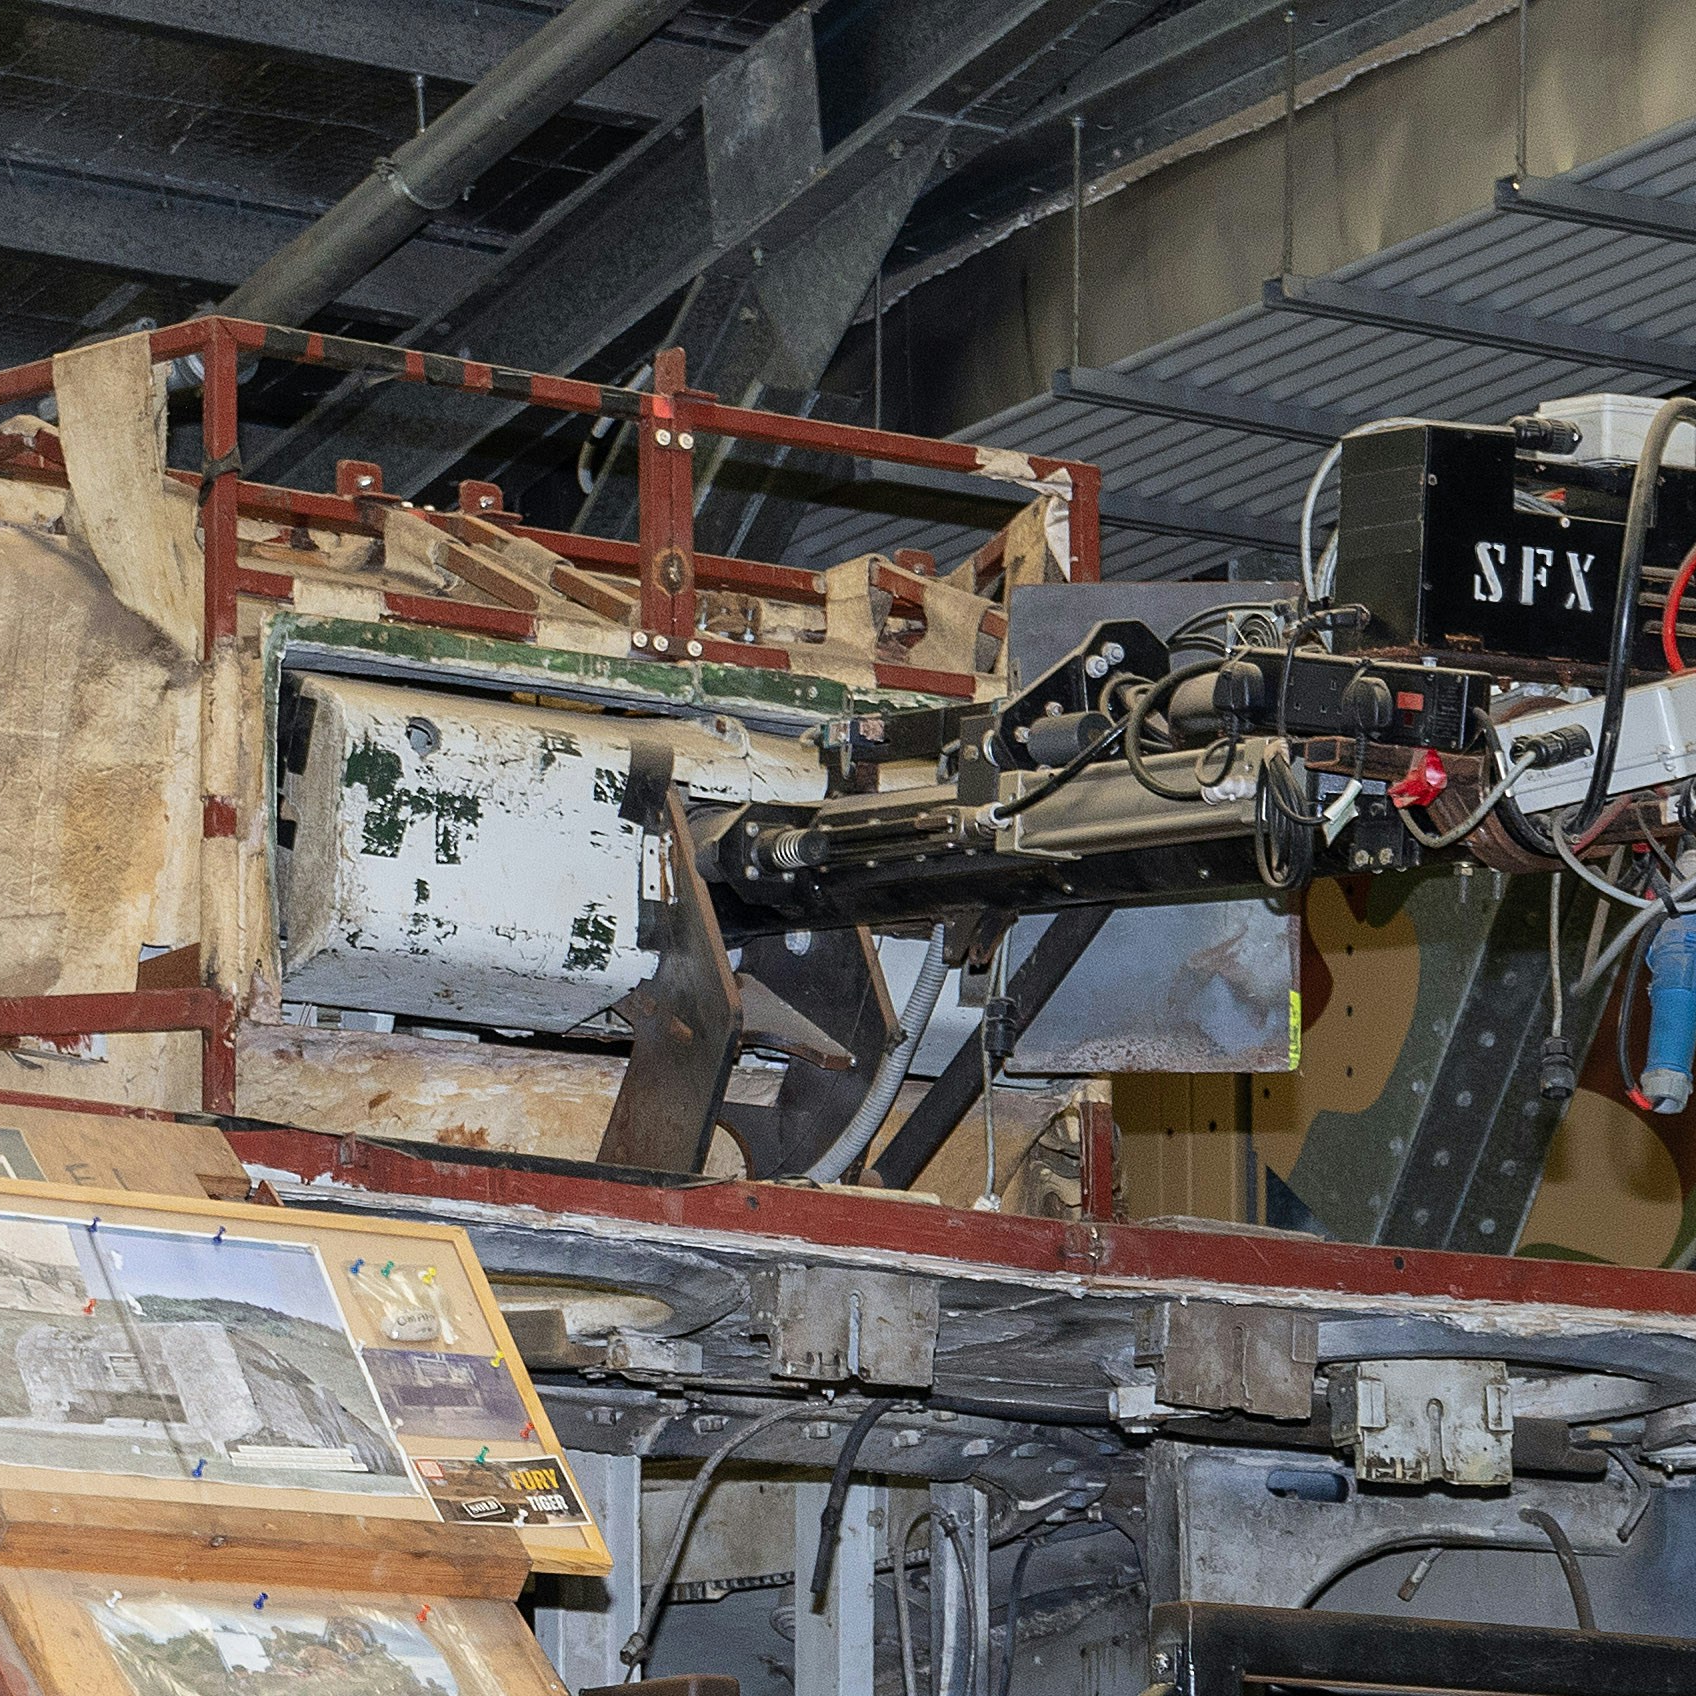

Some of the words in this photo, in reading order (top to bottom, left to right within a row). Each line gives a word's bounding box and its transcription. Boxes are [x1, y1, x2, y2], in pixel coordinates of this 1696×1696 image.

[1473, 541, 1596, 612] SFX
[509, 1468, 560, 1491] FURY
[525, 1494, 569, 1512] TIGER
